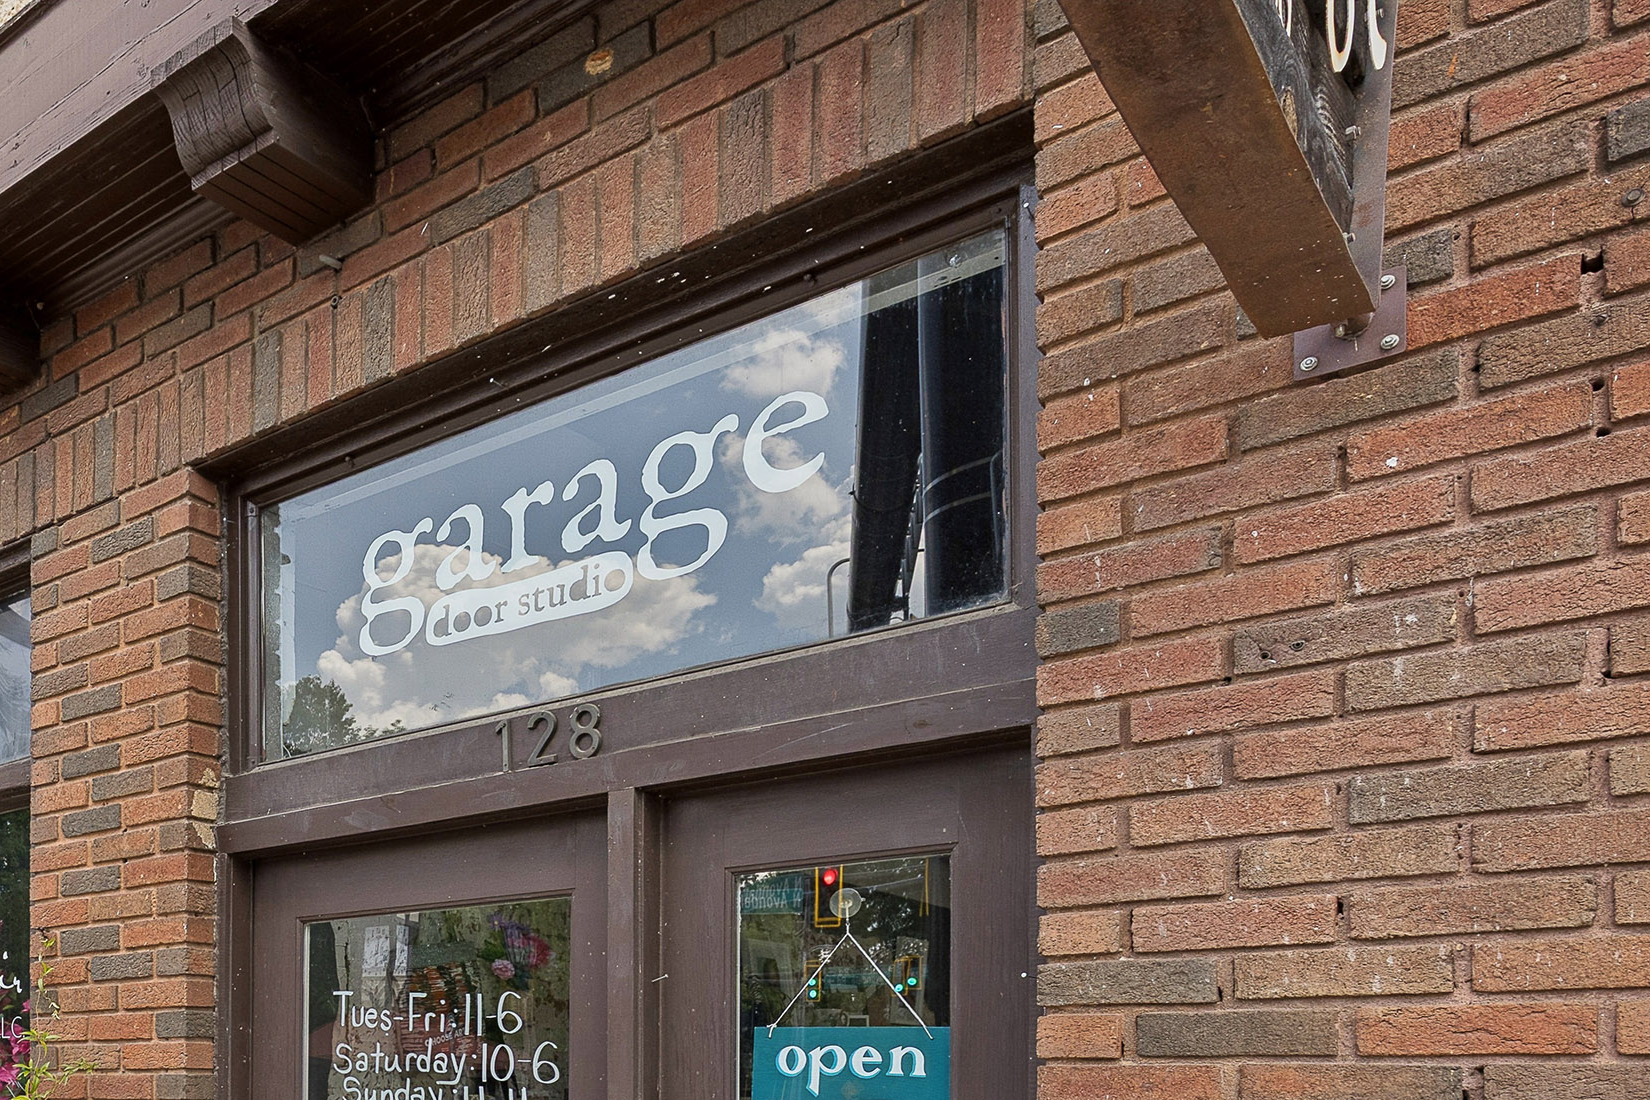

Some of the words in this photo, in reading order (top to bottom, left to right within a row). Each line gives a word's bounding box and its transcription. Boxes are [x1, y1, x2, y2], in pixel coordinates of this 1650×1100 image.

[358, 390, 830, 658] garage
[433, 604, 508, 638] door
[518, 563, 626, 616] studio
[495, 703, 603, 773] 128
[774, 1044, 927, 1098] open
